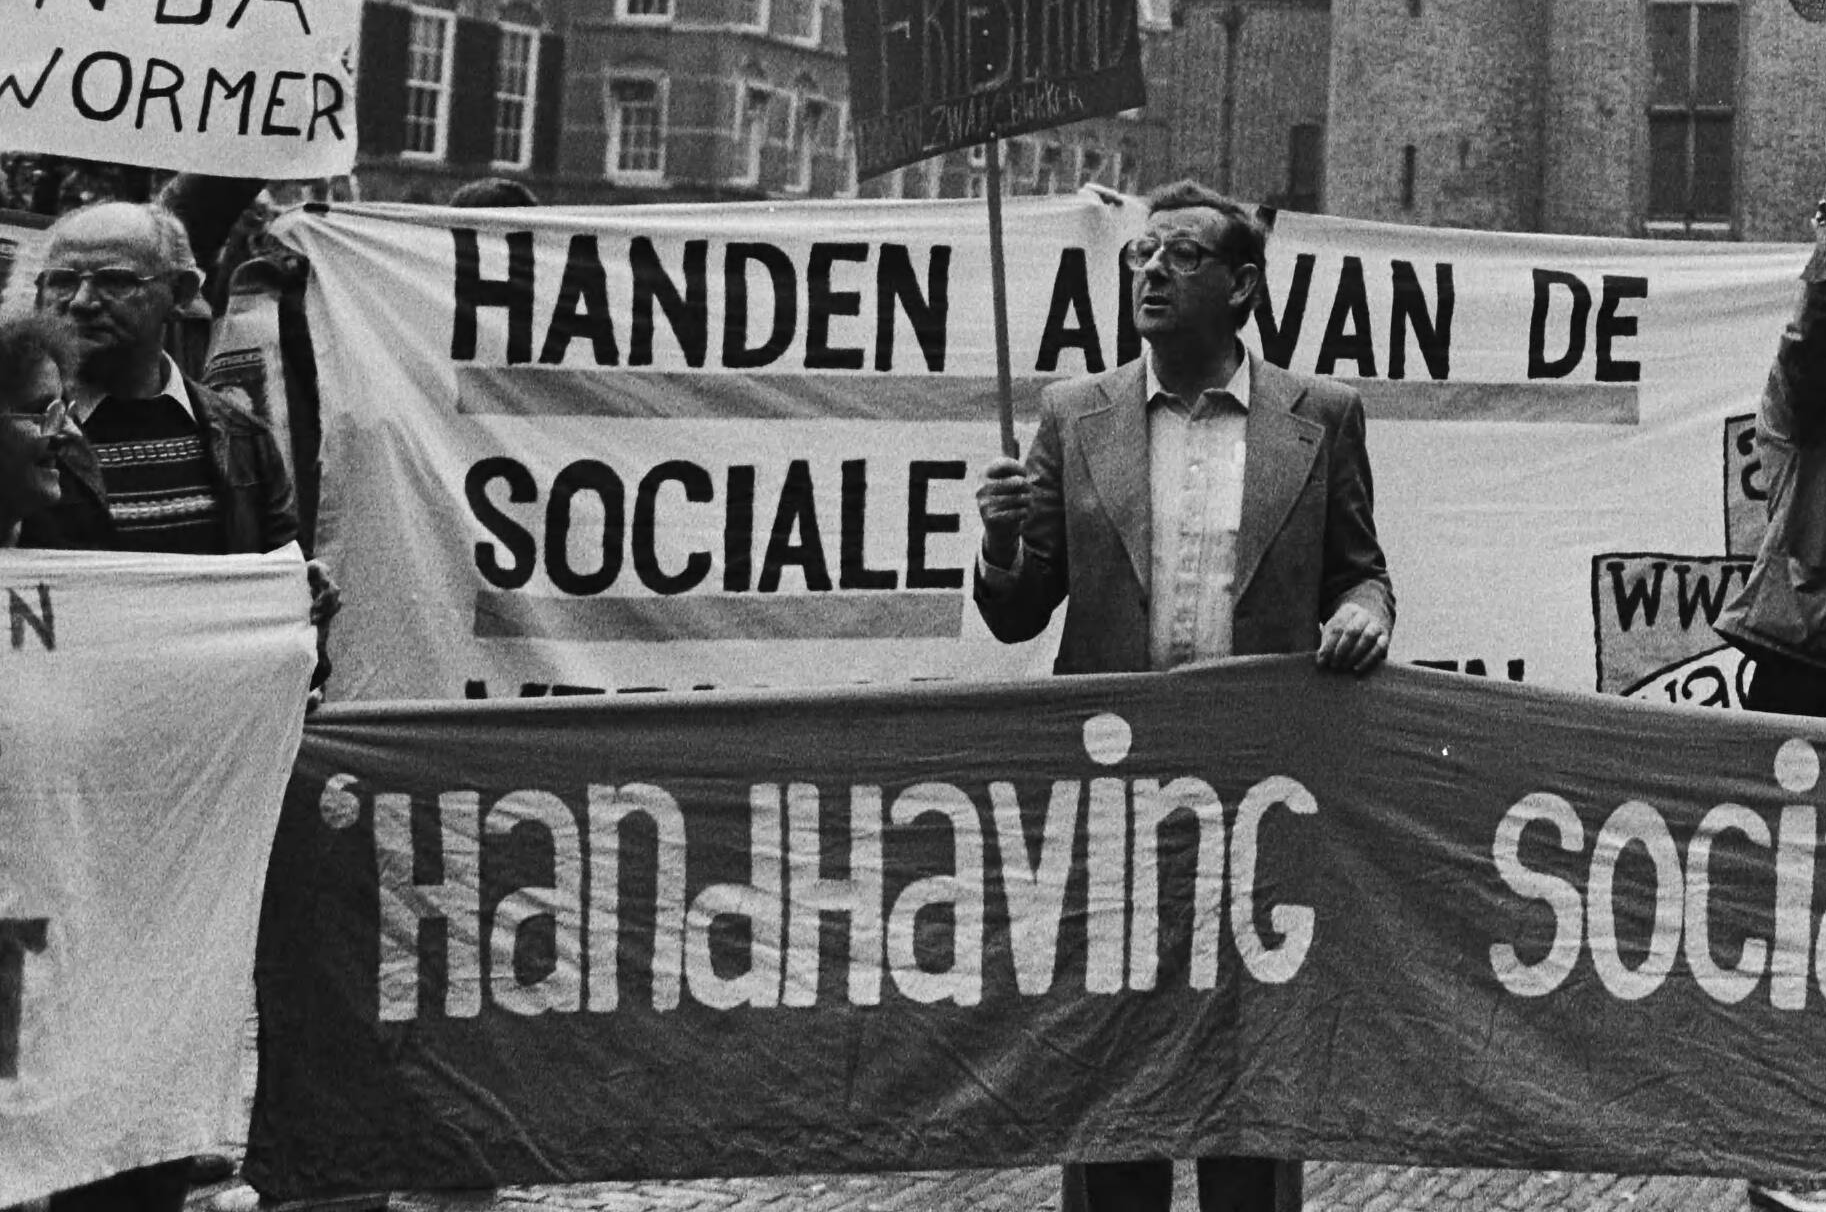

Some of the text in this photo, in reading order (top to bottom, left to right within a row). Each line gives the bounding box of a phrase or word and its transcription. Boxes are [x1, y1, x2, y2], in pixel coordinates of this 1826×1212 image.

[0, 47, 345, 142] WORMER
[450, 228, 952, 372] HANDEN
[1252, 253, 1455, 380] VAN
[1527, 268, 1649, 382] DE
[464, 456, 967, 596] SOCIALE
[1606, 560, 1753, 633] WW
